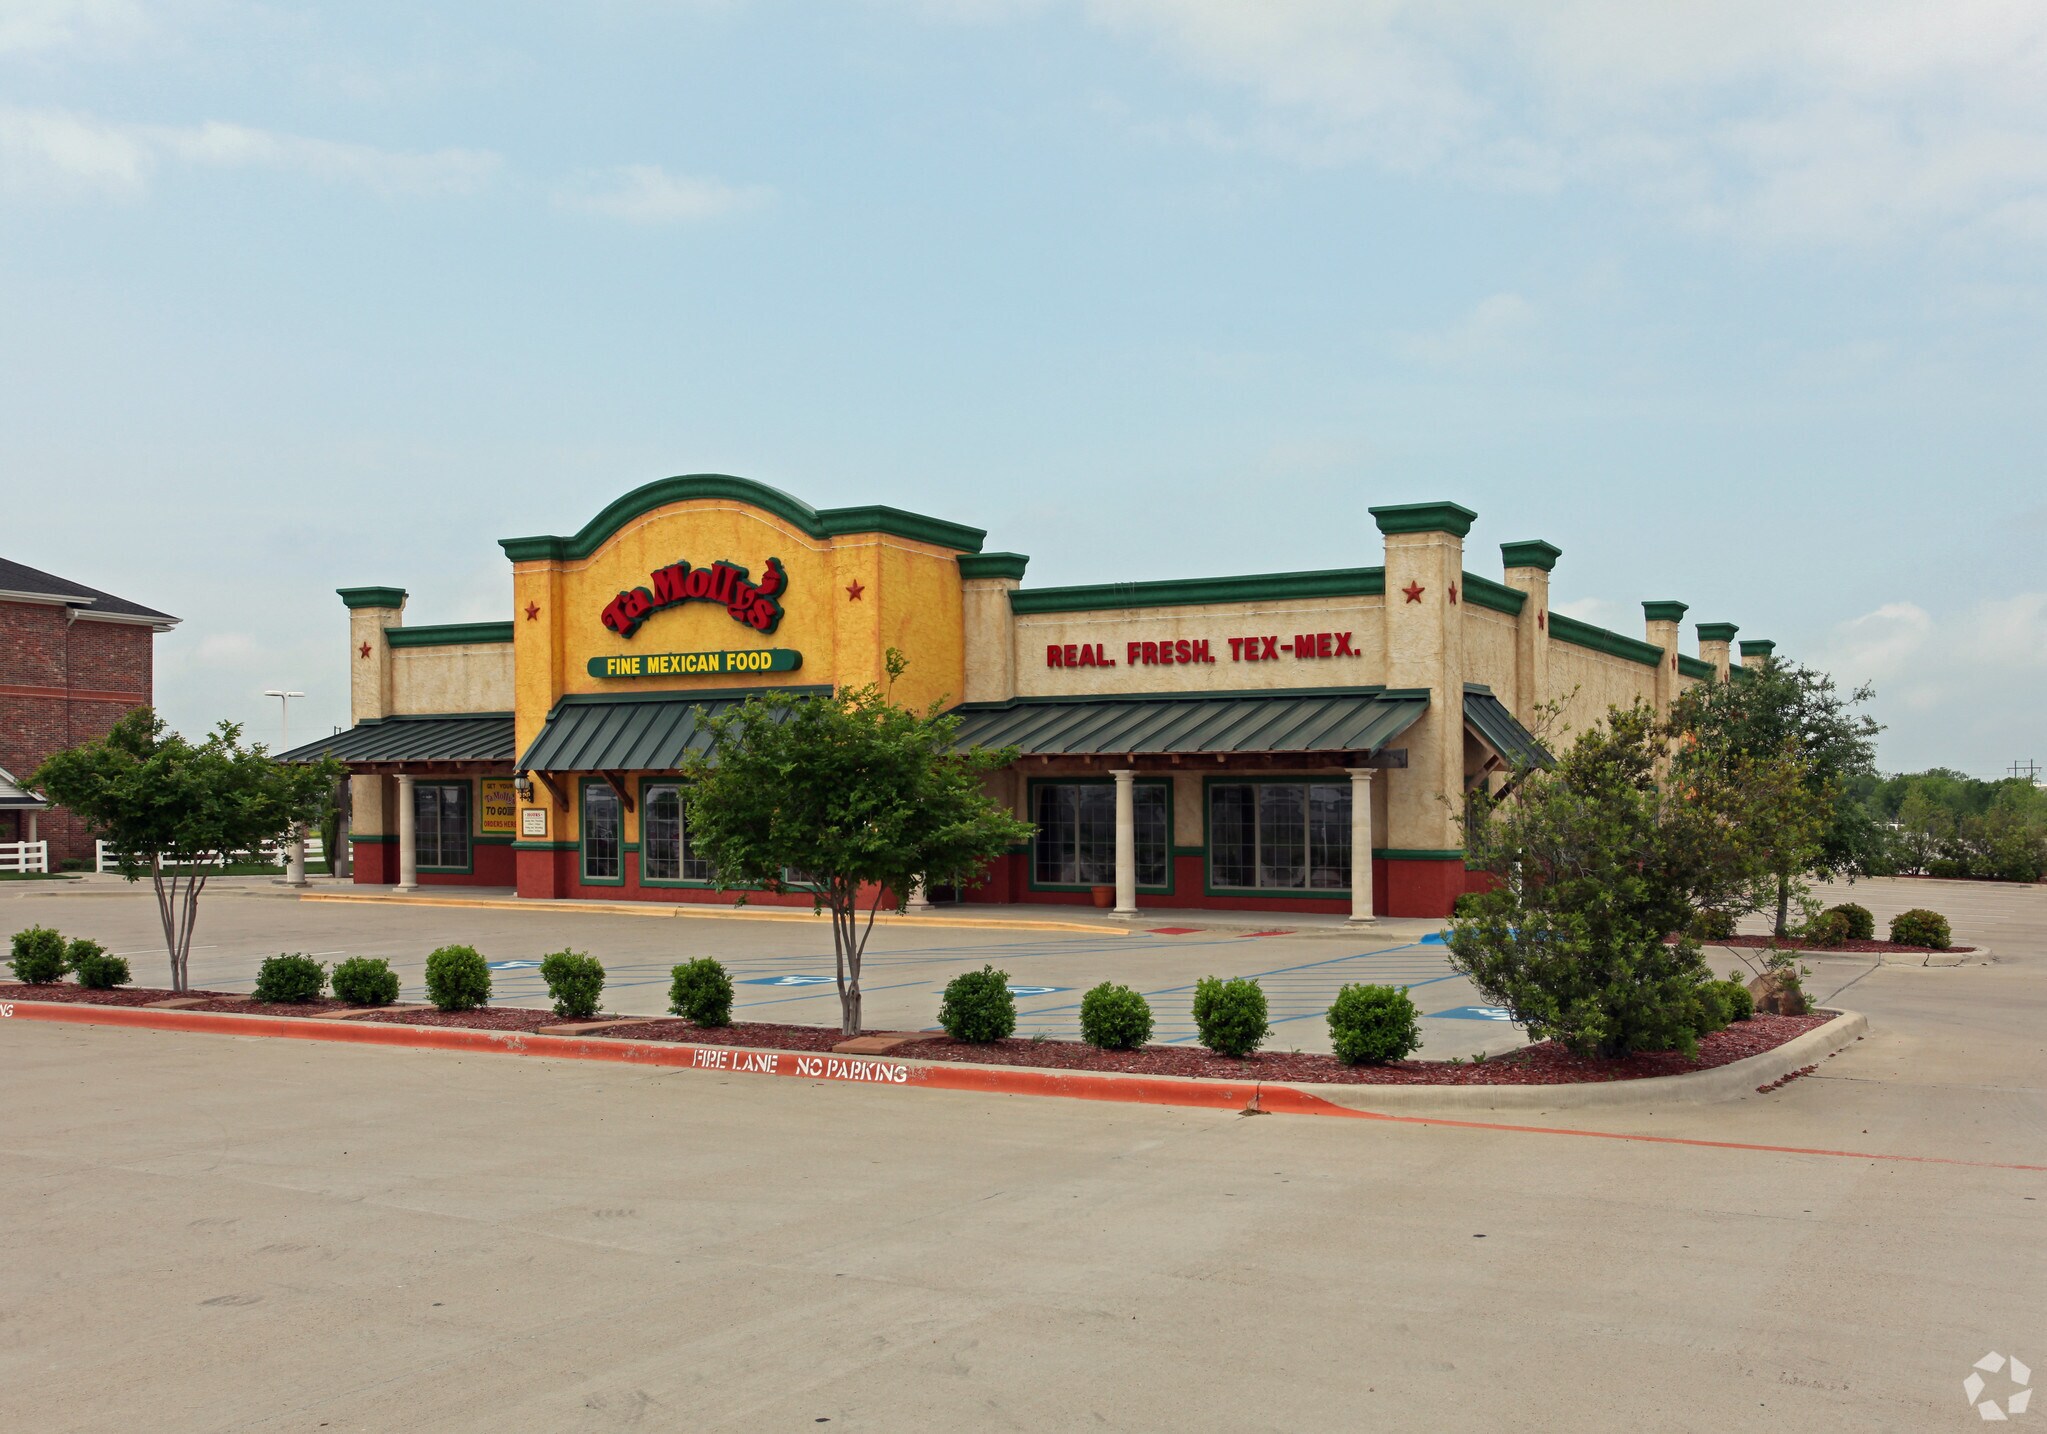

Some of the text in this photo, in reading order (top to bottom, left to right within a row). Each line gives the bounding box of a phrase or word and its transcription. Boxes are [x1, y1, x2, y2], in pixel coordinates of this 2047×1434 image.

[1046, 632, 1361, 667] REAL. FRESH. TEX-MEX.
[607, 652, 772, 675] FINE MEXICAN FOOD
[486, 806, 508, 816] TO GO
[484, 820, 503, 828] ORDERS
[692, 1049, 908, 1083] FIRE LANE NO PARKING
